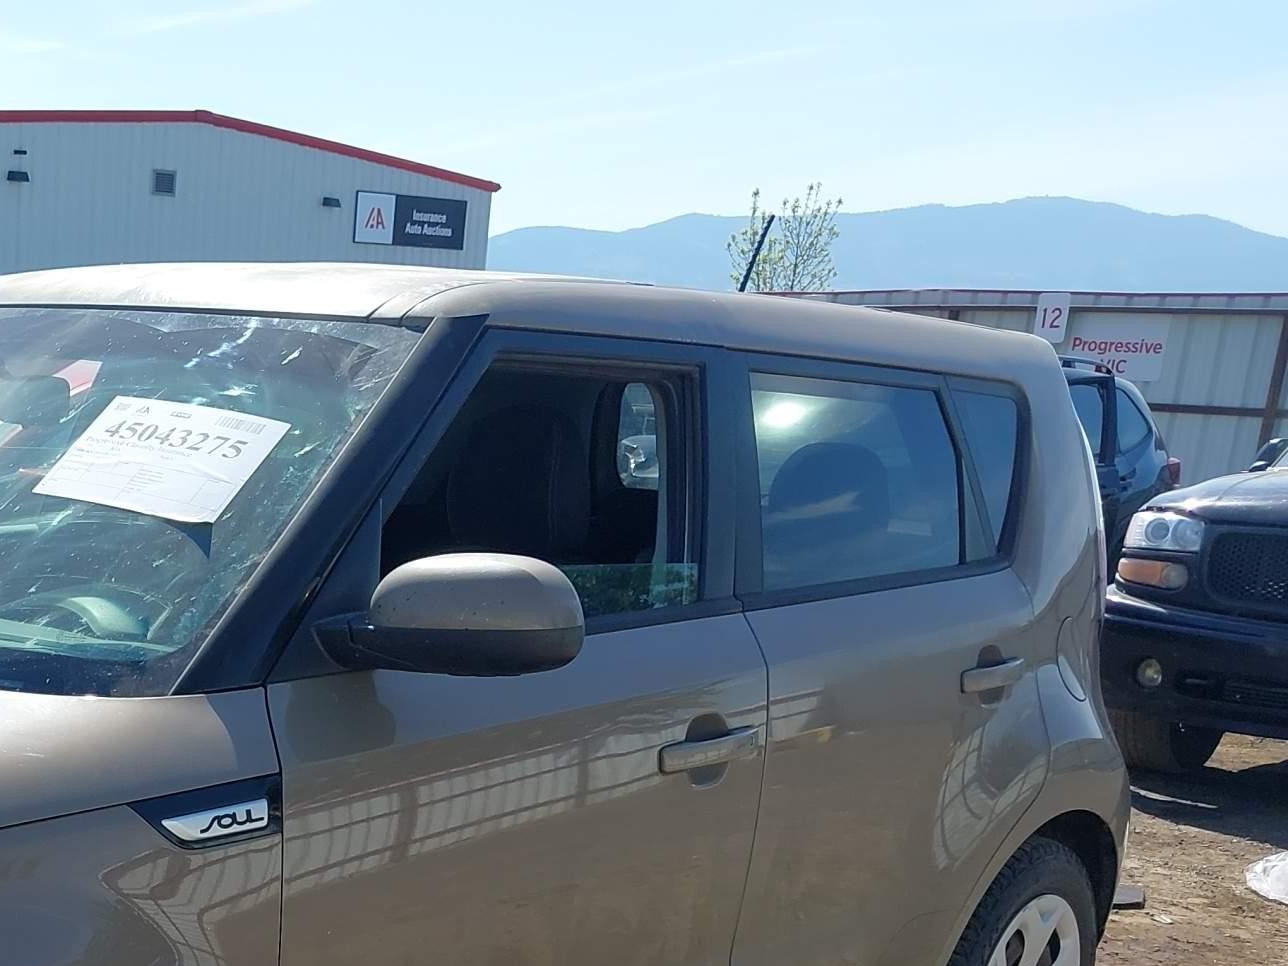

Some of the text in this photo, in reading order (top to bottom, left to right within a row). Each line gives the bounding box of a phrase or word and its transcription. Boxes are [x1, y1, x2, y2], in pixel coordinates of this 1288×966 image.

[412, 208, 448, 224] Insurance
[404, 222, 453, 238] Auto Auctions
[1040, 307, 1063, 329] 12
[1071, 336, 1163, 355] Progressive
[103, 419, 249, 460] 45043275
[199, 808, 265, 834] SOUL
